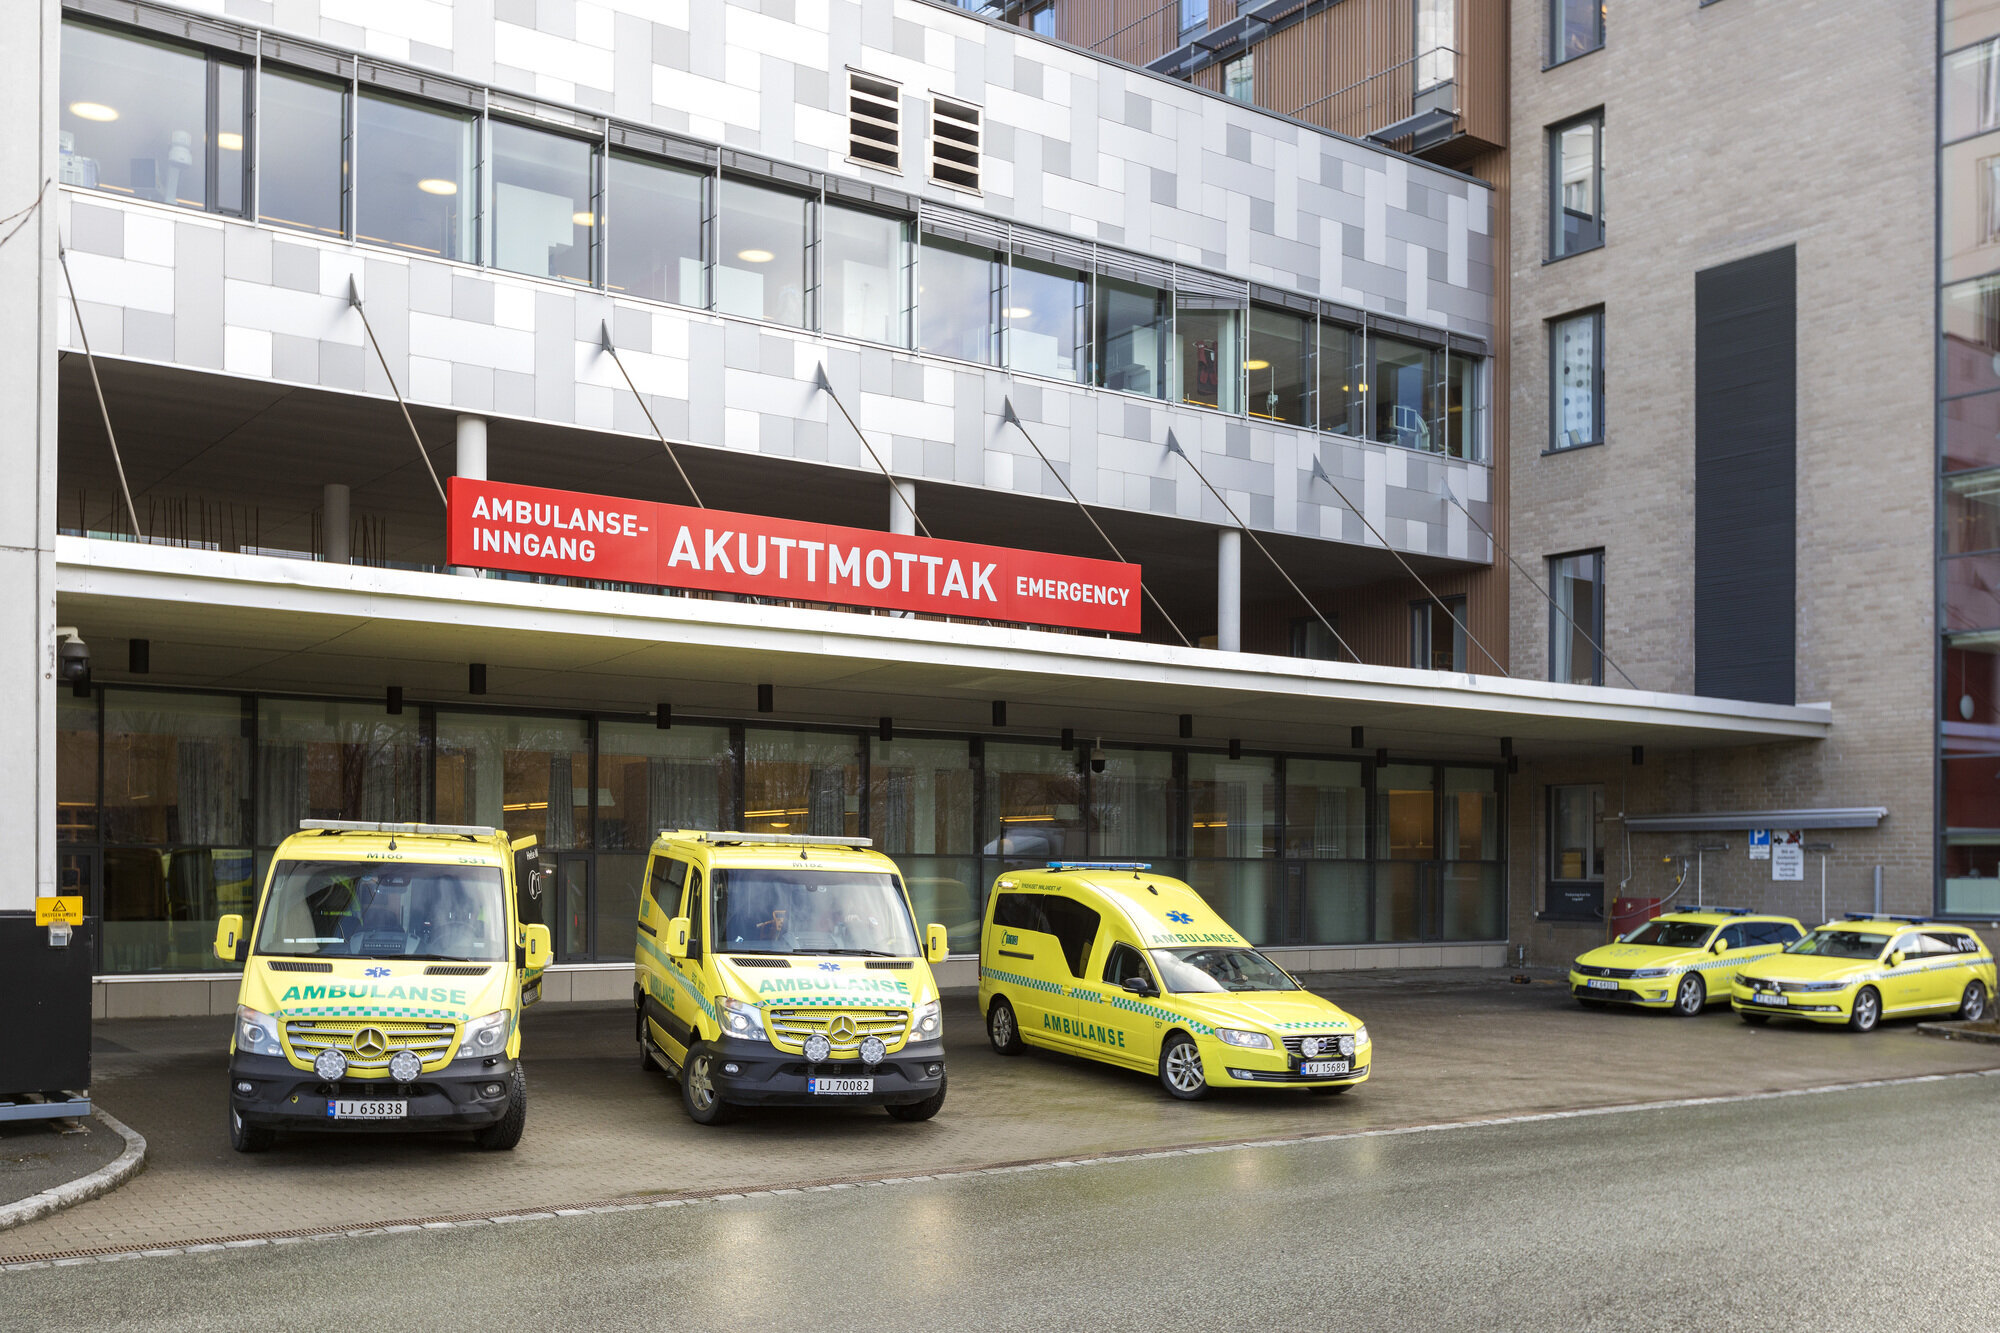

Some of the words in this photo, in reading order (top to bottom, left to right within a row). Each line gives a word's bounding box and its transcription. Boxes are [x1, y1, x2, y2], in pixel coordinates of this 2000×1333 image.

[472, 496, 649, 537] AMBULANSE-
[473, 527, 596, 562] INNGANG
[667, 525, 998, 602] AKUTTMOTTAK
[1016, 576, 1130, 607] EMERGENCY
[1152, 933, 1239, 944] AMBULANSE
[281, 985, 467, 1006] AMBULANSE
[759, 978, 911, 995] AMBULANSE
[1044, 1013, 1126, 1048] AMBULANSE
[1308, 1063, 1319, 1073] KJ
[1322, 1062, 1346, 1073] 15689
[819, 1080, 831, 1091] LJ
[835, 1080, 869, 1091] 70082
[340, 1102, 354, 1115] LJ
[360, 1102, 402, 1115] 65838
